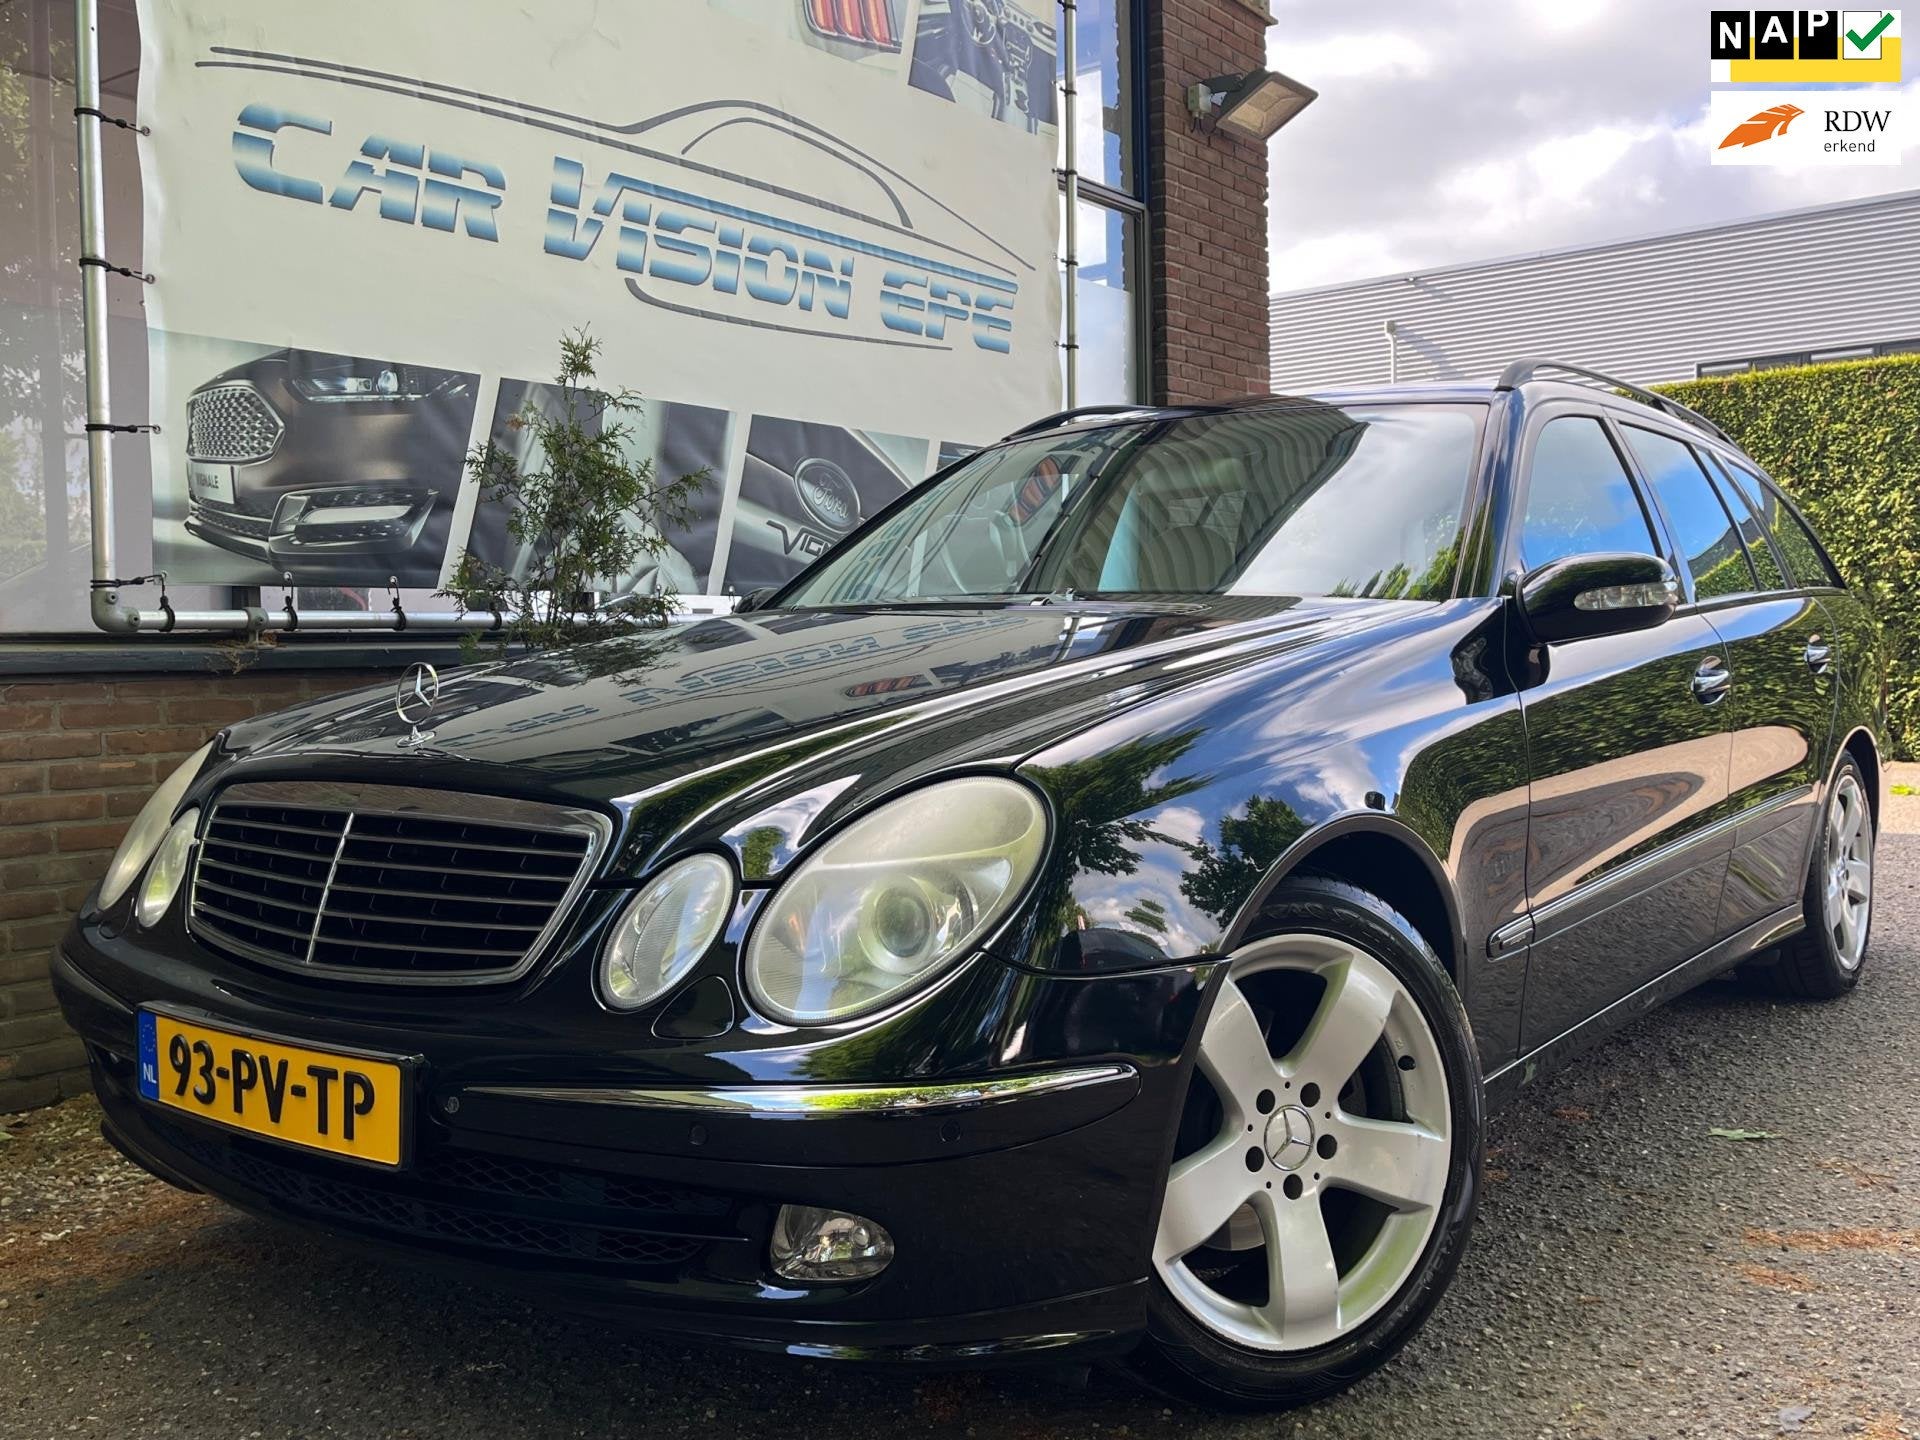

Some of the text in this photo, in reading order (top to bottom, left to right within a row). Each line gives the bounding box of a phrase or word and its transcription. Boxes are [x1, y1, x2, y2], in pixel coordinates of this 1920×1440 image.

[232, 103, 1018, 354] CAR VISION EPE
[143, 1064, 157, 1084] NL
[169, 1033, 375, 1141] 93-PV-TP
